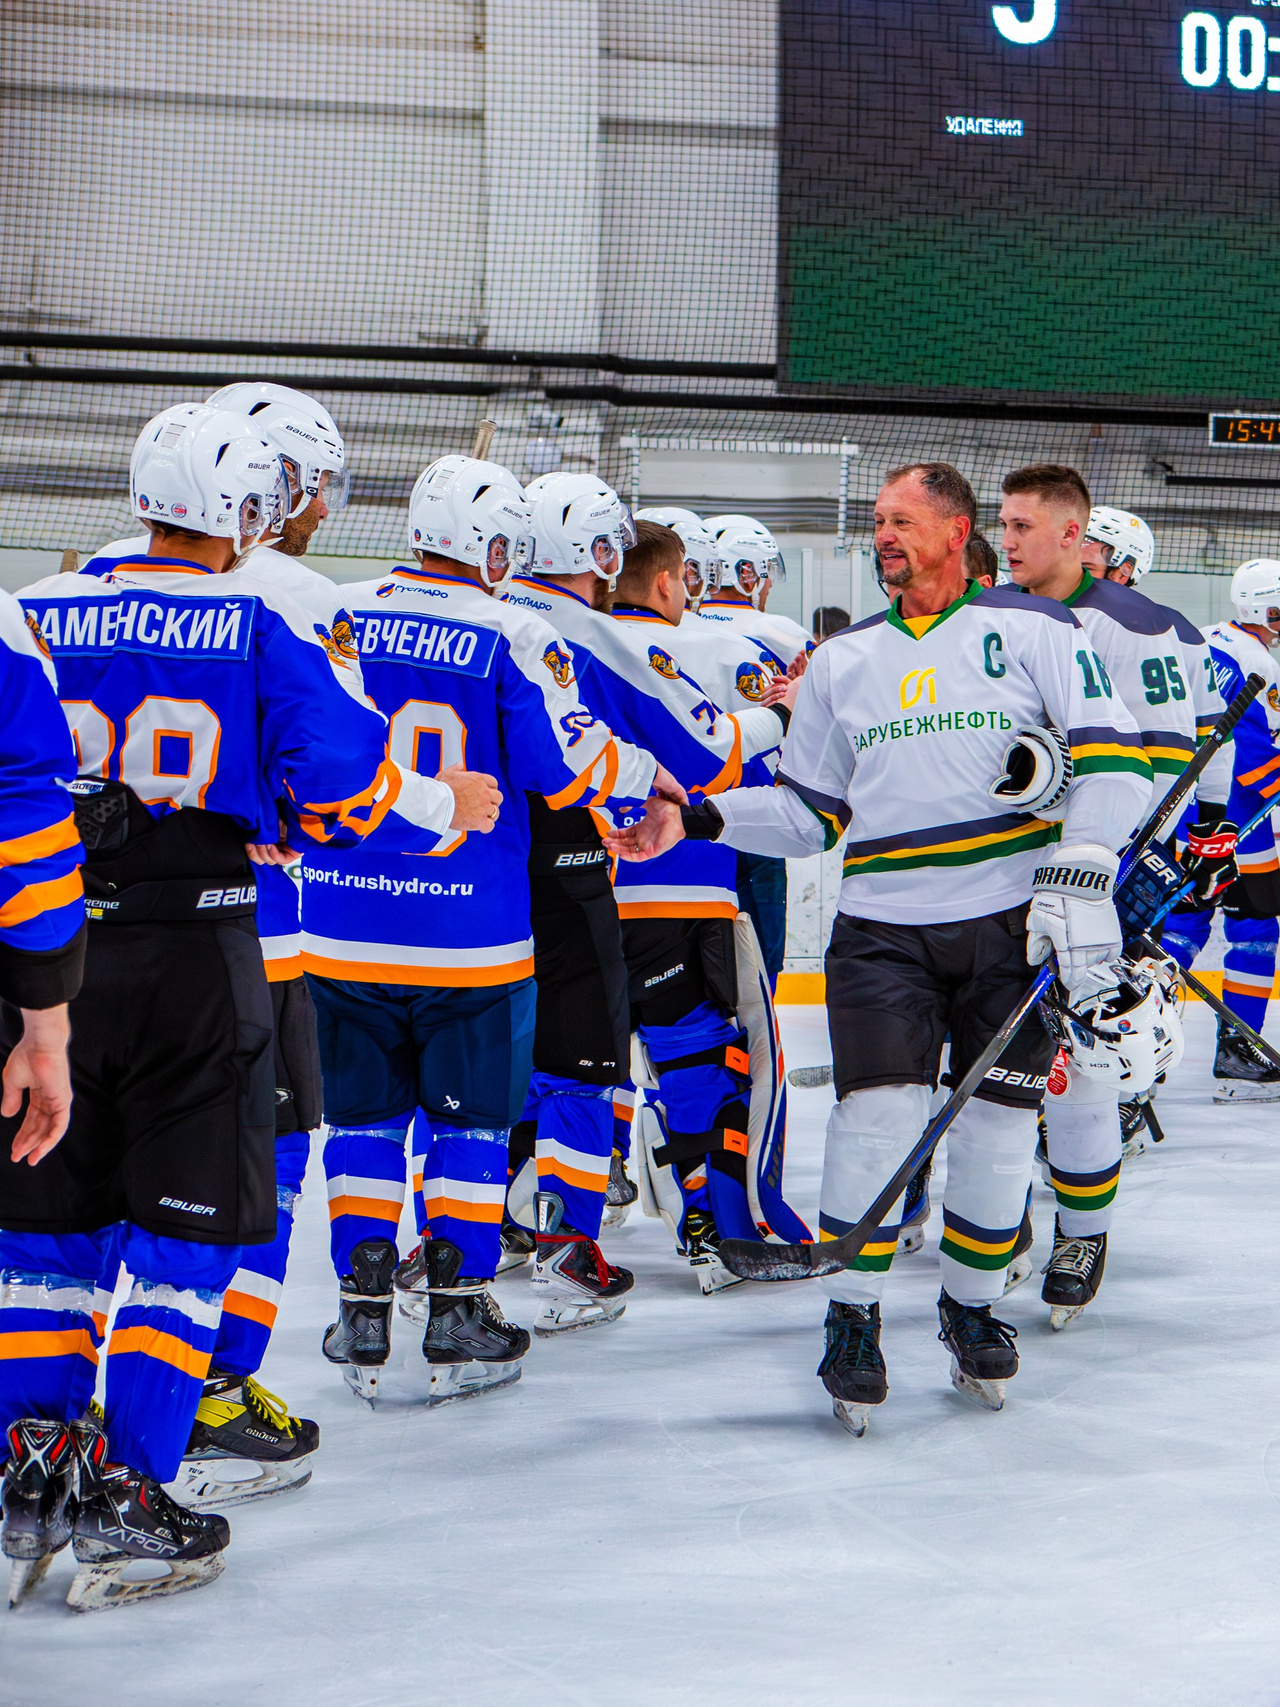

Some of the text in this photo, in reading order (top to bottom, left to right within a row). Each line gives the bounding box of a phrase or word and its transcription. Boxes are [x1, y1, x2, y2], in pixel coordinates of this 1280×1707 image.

[354, 617, 479, 667] ЕВЧЕНКО
[983, 632, 1007, 679] C
[1140, 655, 1187, 706] 95
[303, 865, 474, 896] sport.rushydro.ru
[644, 963, 685, 988] BAUER
[158, 1197, 217, 1217] BAUER
[98, 1516, 180, 1556] VAPOR
